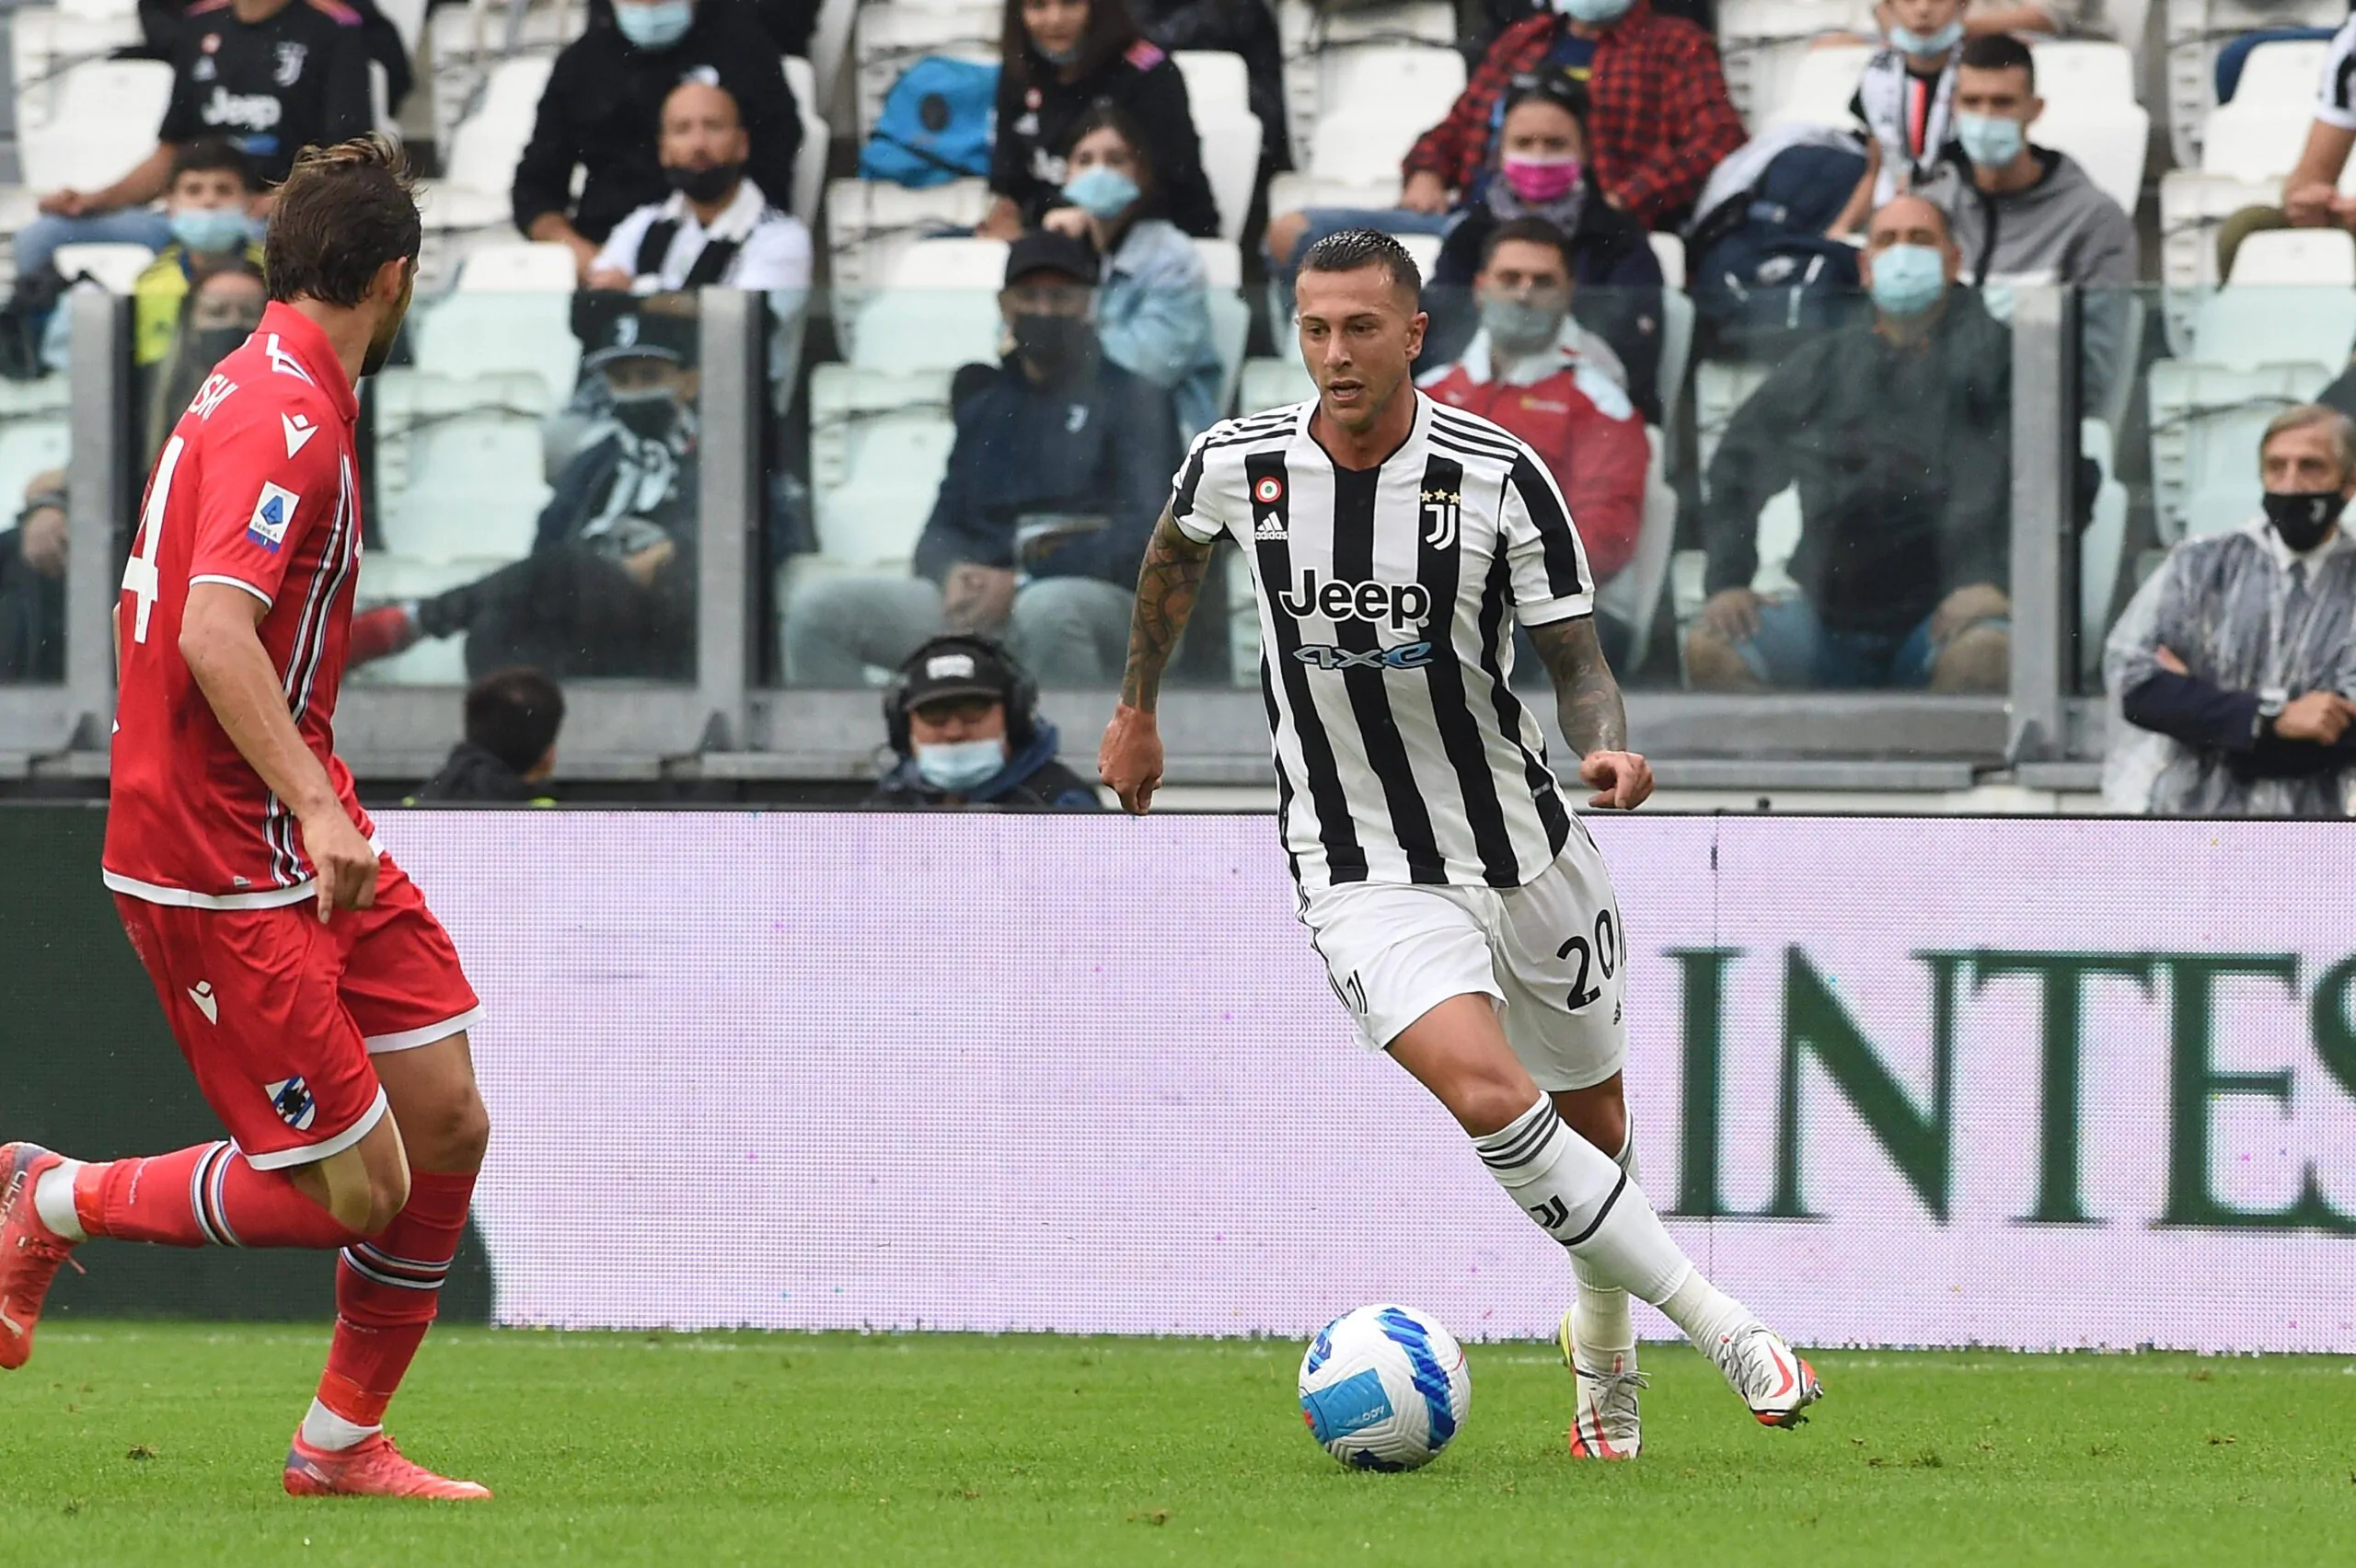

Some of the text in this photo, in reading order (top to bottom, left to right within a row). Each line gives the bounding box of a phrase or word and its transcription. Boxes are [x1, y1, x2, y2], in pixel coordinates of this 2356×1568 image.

[1254, 530, 1288, 541] adidas
[1278, 567, 1431, 632] Jeep
[1556, 908, 1615, 1011] 20
